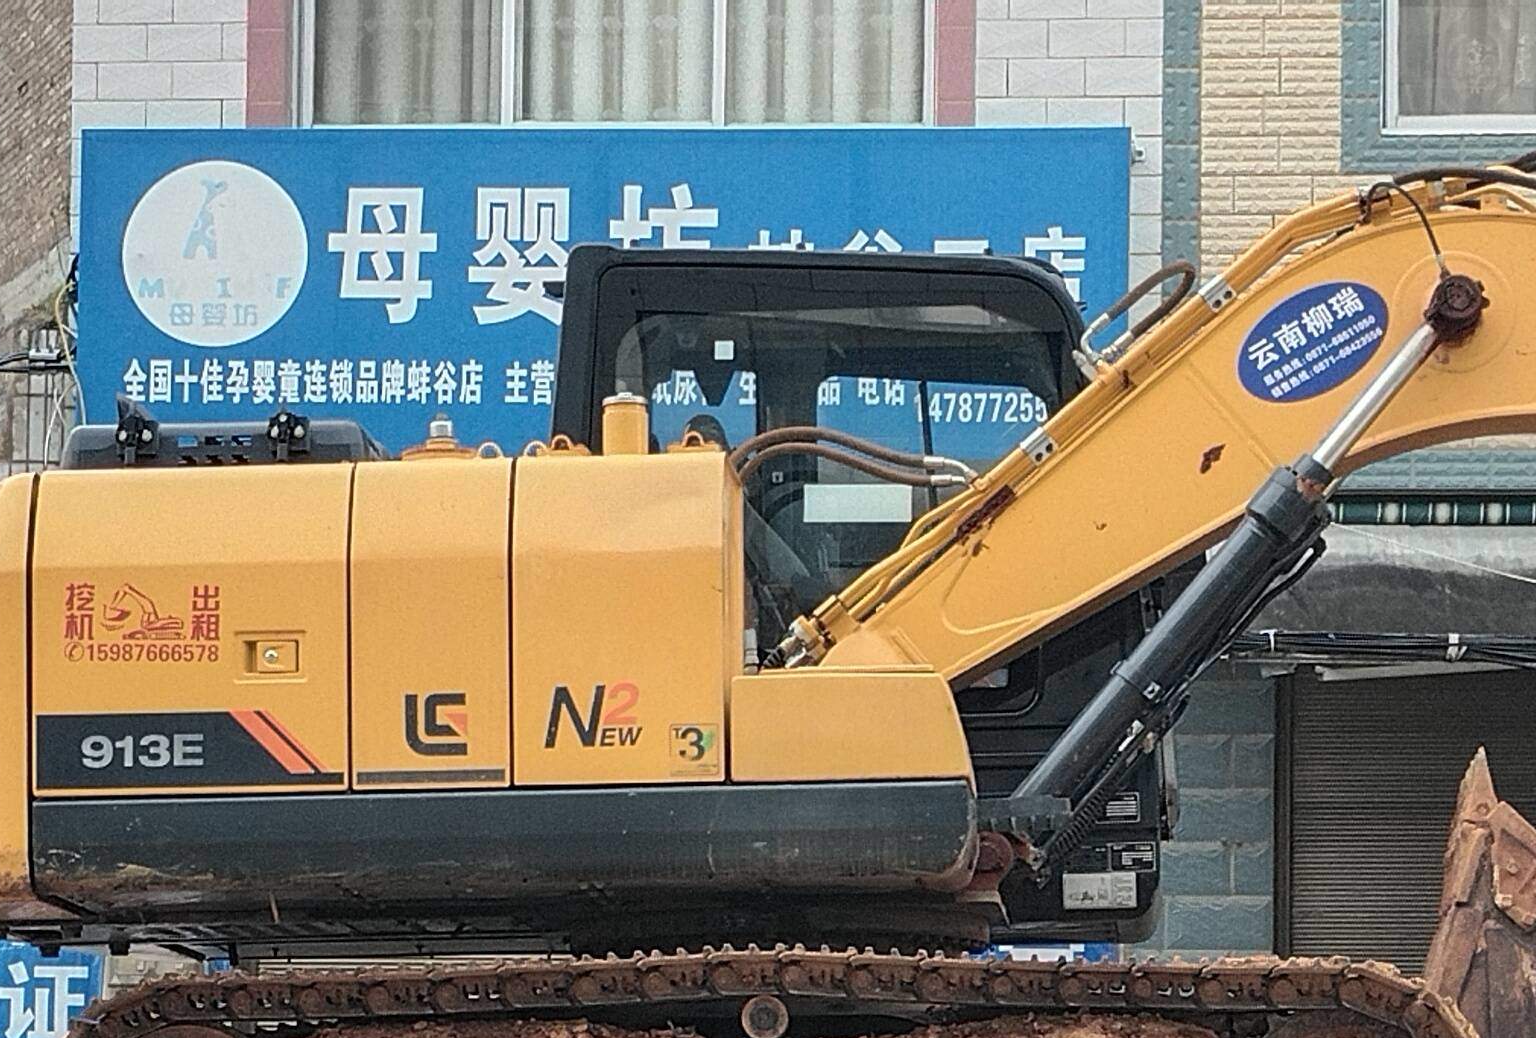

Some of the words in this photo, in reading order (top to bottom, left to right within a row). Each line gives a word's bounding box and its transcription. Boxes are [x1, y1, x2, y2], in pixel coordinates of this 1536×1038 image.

[169, 303, 258, 326] 母婴坊
[1248, 286, 1365, 371] 云南柳瑞
[123, 358, 484, 404] 全国十佳孕婴童连锁品牌蚌谷店
[86, 644, 219, 662] 15987666578
[80, 733, 204, 769] 913E
